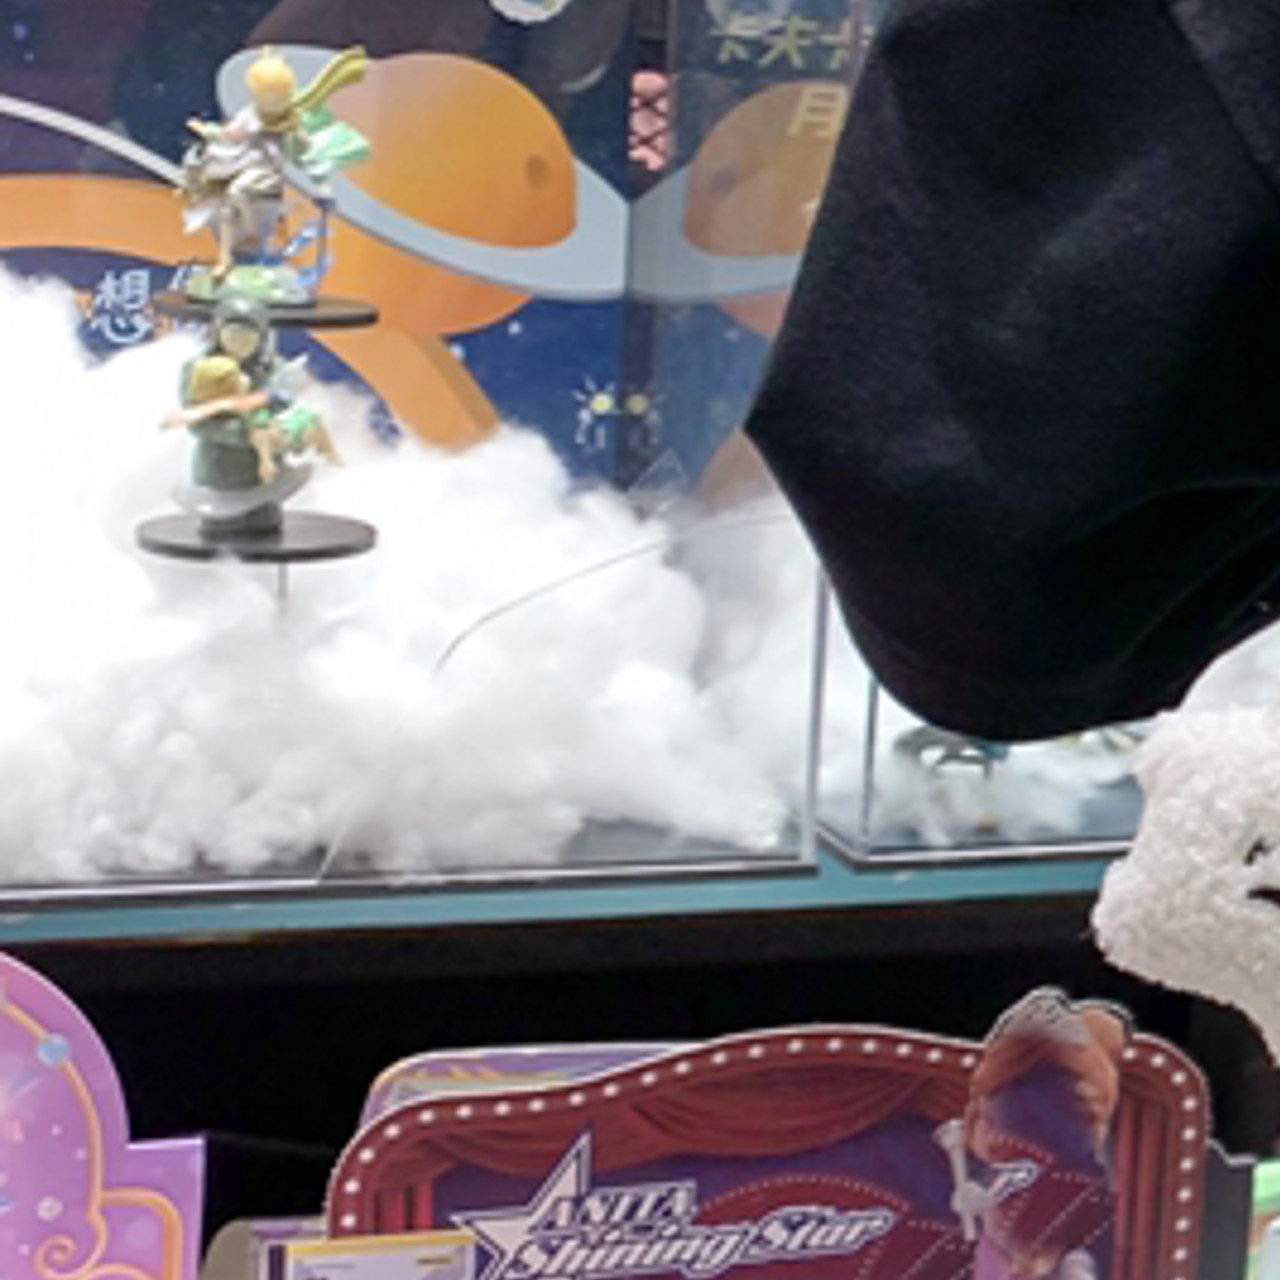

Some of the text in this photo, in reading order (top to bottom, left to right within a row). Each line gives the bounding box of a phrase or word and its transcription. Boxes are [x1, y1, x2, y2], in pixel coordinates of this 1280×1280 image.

[531, 1180, 698, 1230] ANITA
[506, 1207, 894, 1277] Shining Star
